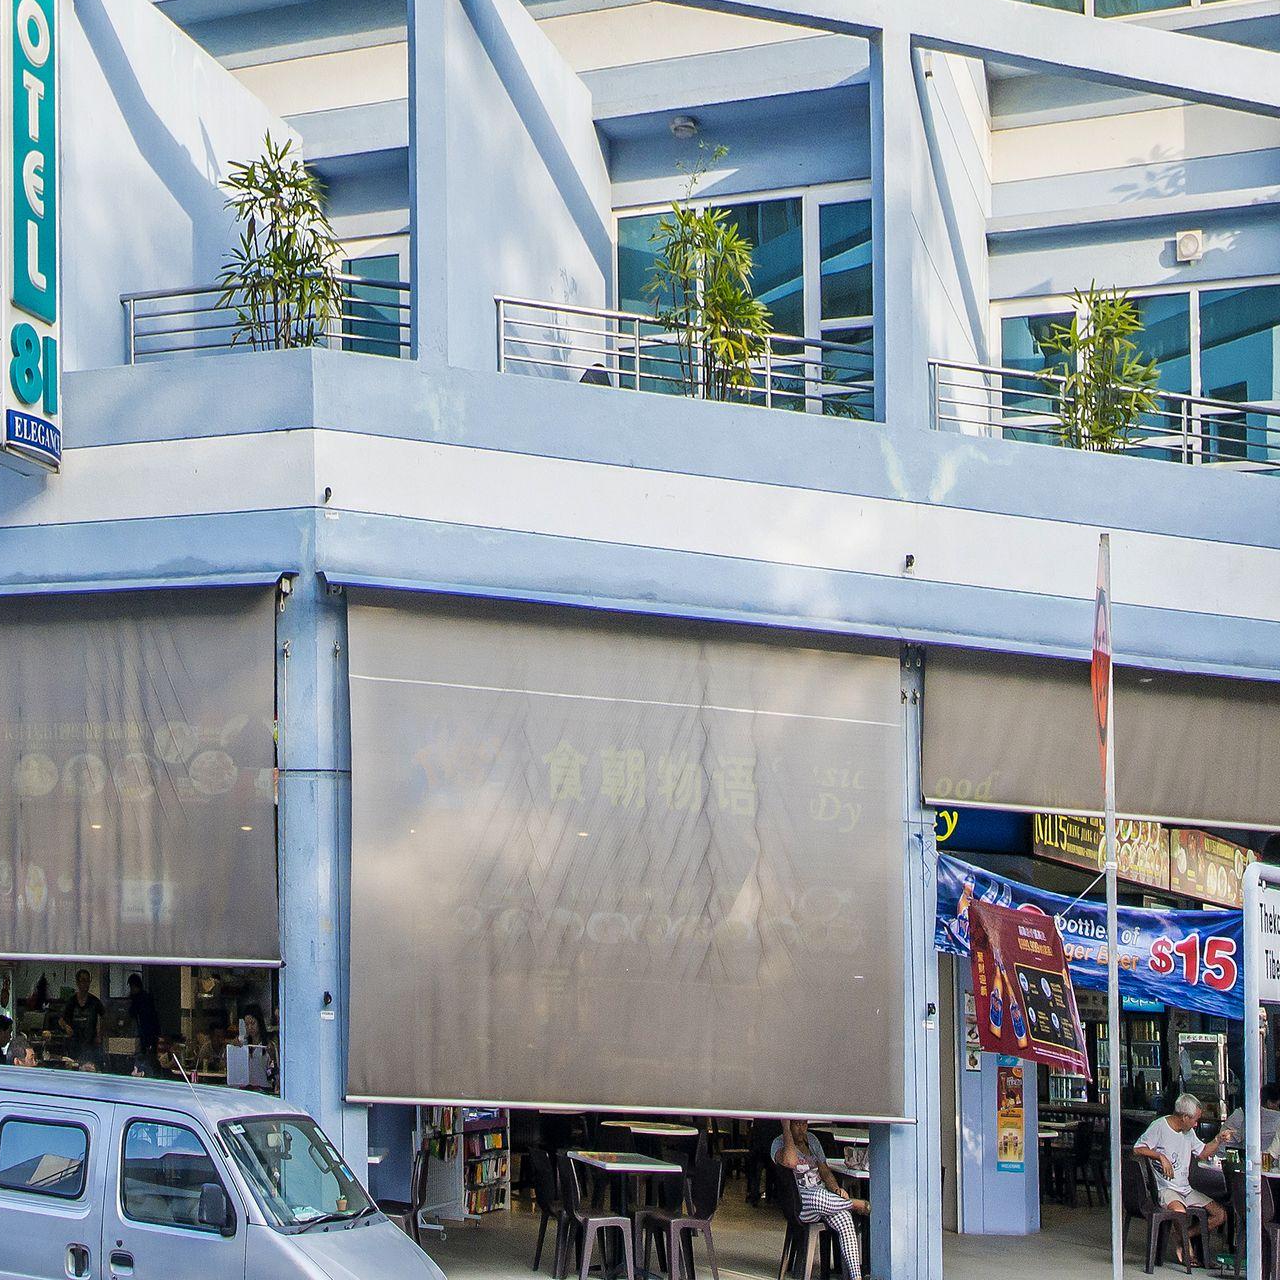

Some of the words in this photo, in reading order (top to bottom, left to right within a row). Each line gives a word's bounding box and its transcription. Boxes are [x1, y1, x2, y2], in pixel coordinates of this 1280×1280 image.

[10, 322, 57, 415] 81
[1058, 916, 1108, 940] bottle
[1121, 926, 1141, 945] of
[1065, 943, 1094, 963] ger
[1097, 945, 1141, 972] Ber
[1148, 932, 1238, 992] $15
